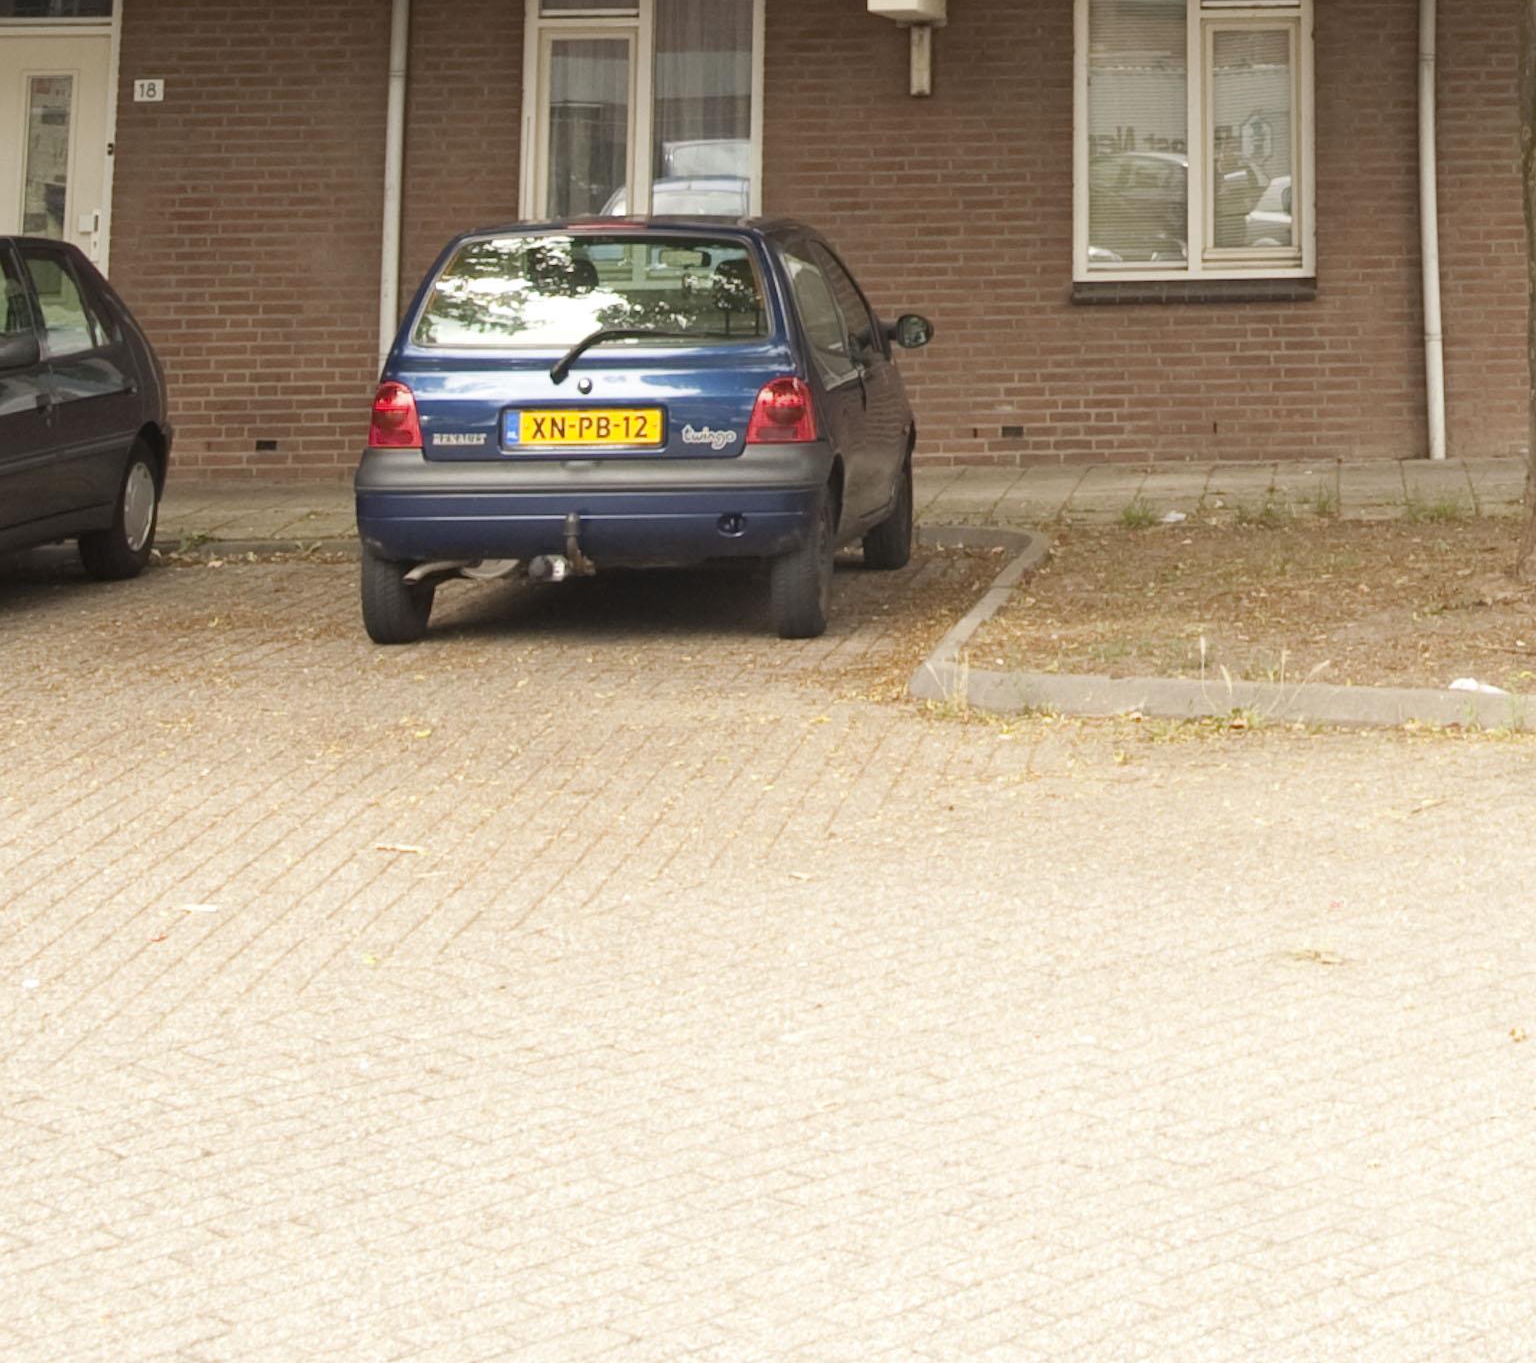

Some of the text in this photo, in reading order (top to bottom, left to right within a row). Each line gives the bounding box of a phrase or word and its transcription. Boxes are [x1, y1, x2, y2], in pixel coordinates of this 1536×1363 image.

[138, 82, 157, 99] 18
[531, 415, 649, 440] XN-PB-12
[681, 425, 737, 449] twingo
[431, 433, 487, 446] RENAULT
